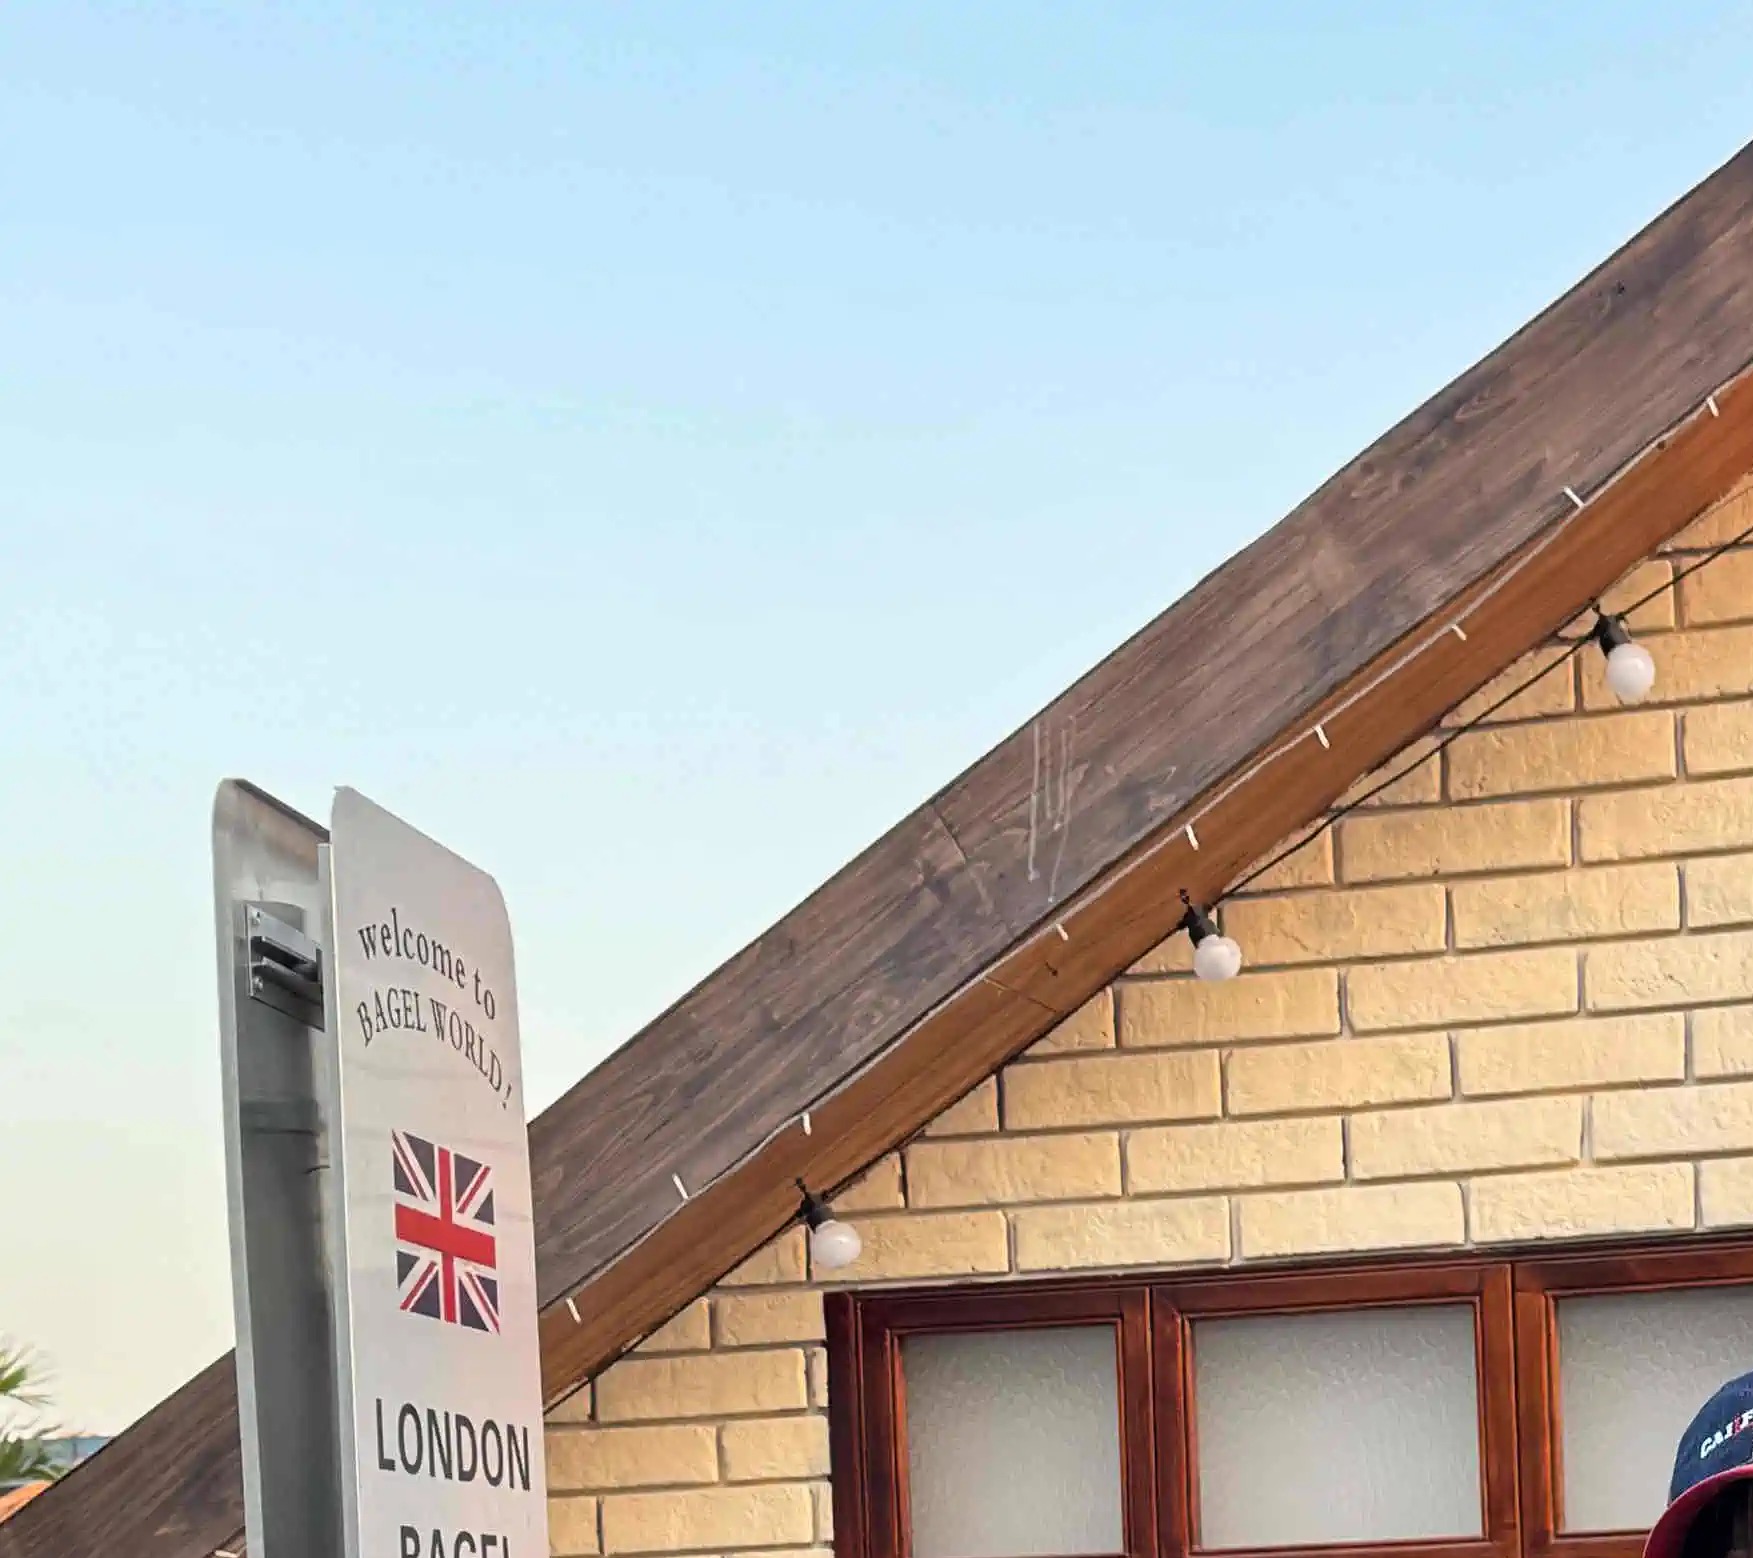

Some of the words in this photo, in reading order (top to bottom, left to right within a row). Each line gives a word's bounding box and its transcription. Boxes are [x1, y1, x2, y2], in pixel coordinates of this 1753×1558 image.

[357, 907, 466, 989] welcome
[472, 967, 496, 1020] to
[356, 986, 428, 1048] BAGEL
[429, 997, 513, 1111] WORLD!
[375, 1396, 532, 1492] LONDON
